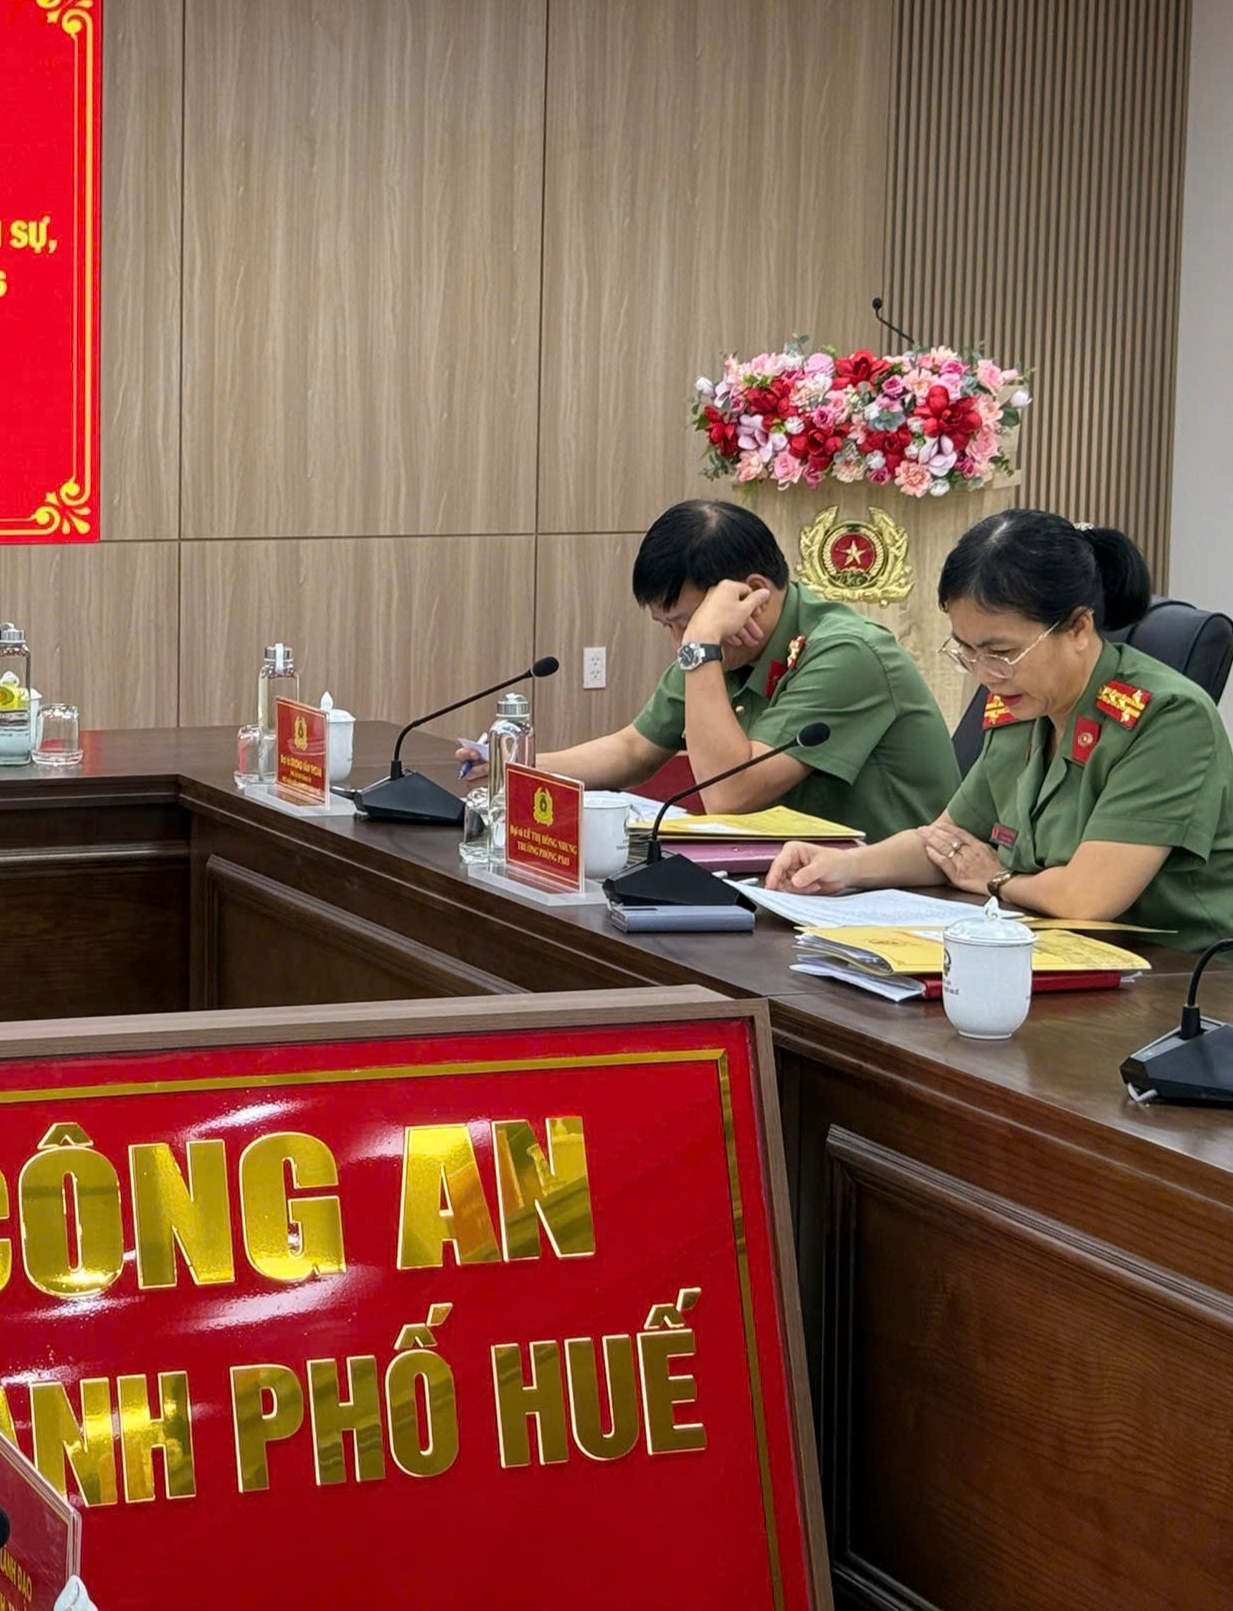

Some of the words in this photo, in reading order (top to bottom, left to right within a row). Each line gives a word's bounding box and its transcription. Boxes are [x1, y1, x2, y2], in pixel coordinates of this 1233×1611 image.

[10, 217, 56, 253] SỰ,
[397, 1116, 595, 1270] AN
[229, 1302, 459, 1493] PHỐ
[491, 1287, 707, 1468] HUẾ
